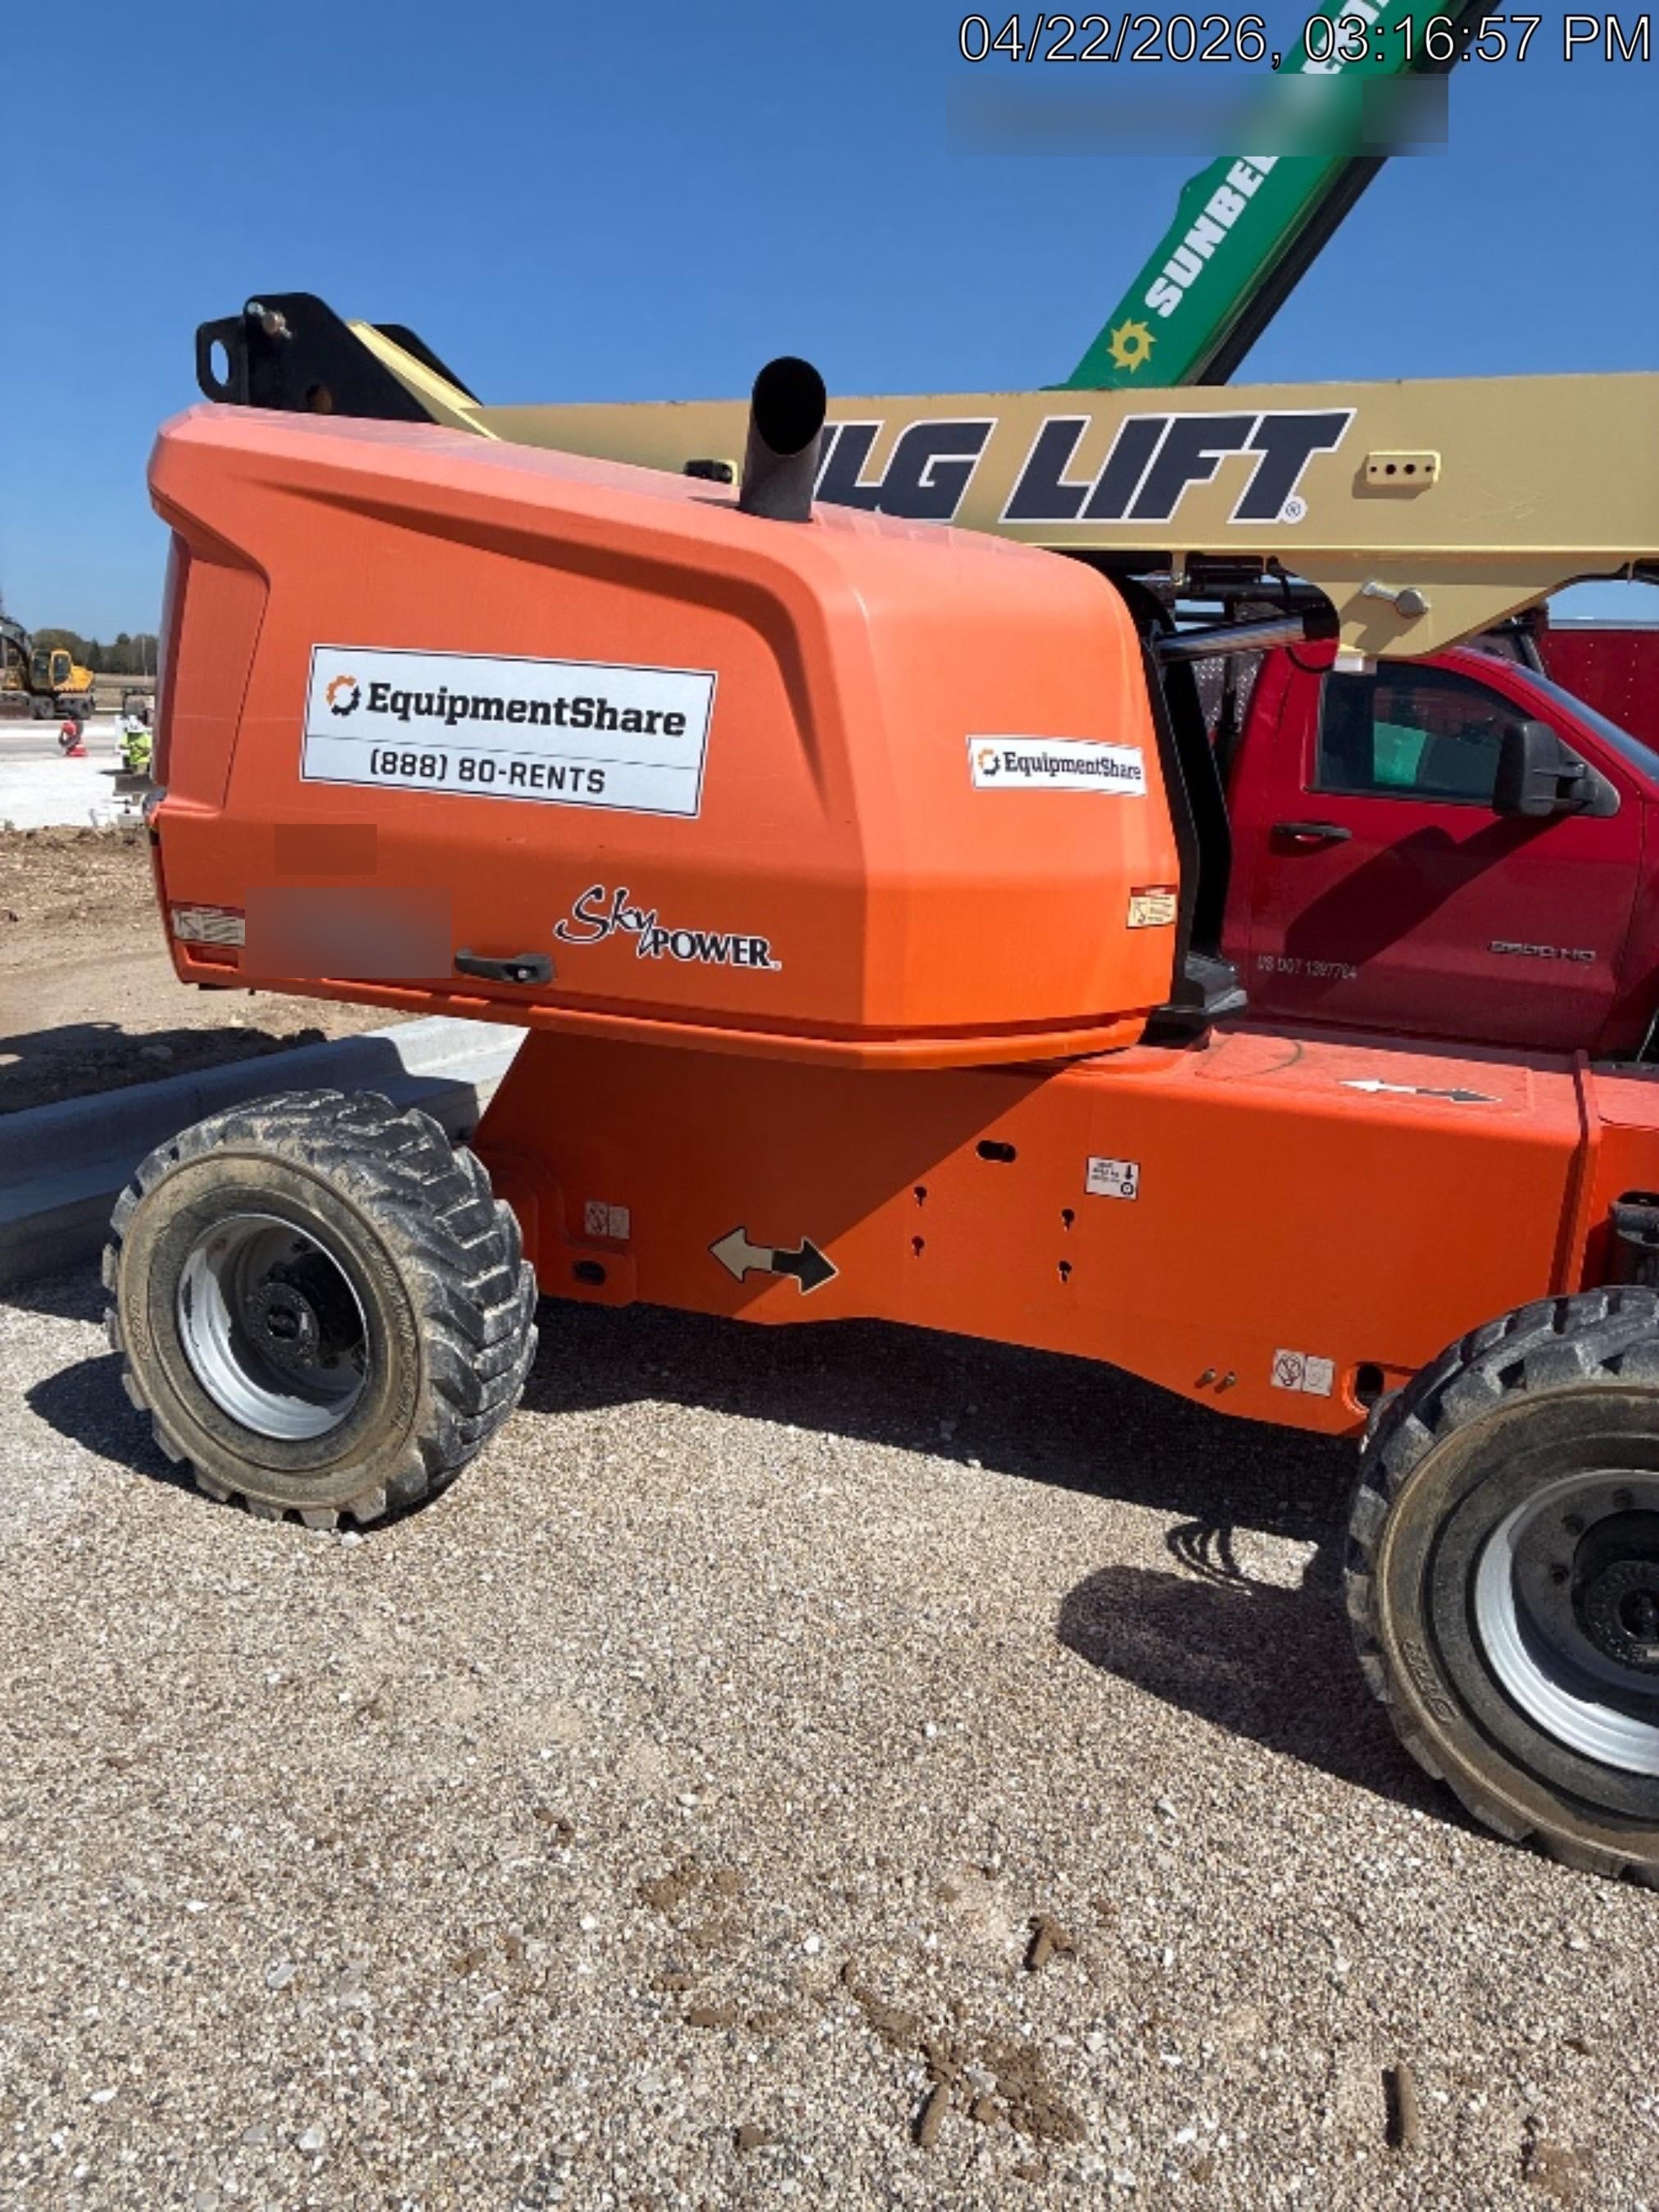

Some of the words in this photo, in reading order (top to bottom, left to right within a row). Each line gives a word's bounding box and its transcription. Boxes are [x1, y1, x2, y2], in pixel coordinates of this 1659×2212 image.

[1145, 156, 1281, 318] SUNBEL
[813, 418, 998, 523] LG
[366, 682, 687, 737] EquipmentShare
[369, 749, 447, 781] (888)
[459, 758, 606, 794] 80-RENTS
[1003, 751, 1141, 779] EquipmentShare
[554, 884, 657, 959] Sky
[1258, 954, 1274, 972] US
[1278, 956, 1301, 974] DOT
